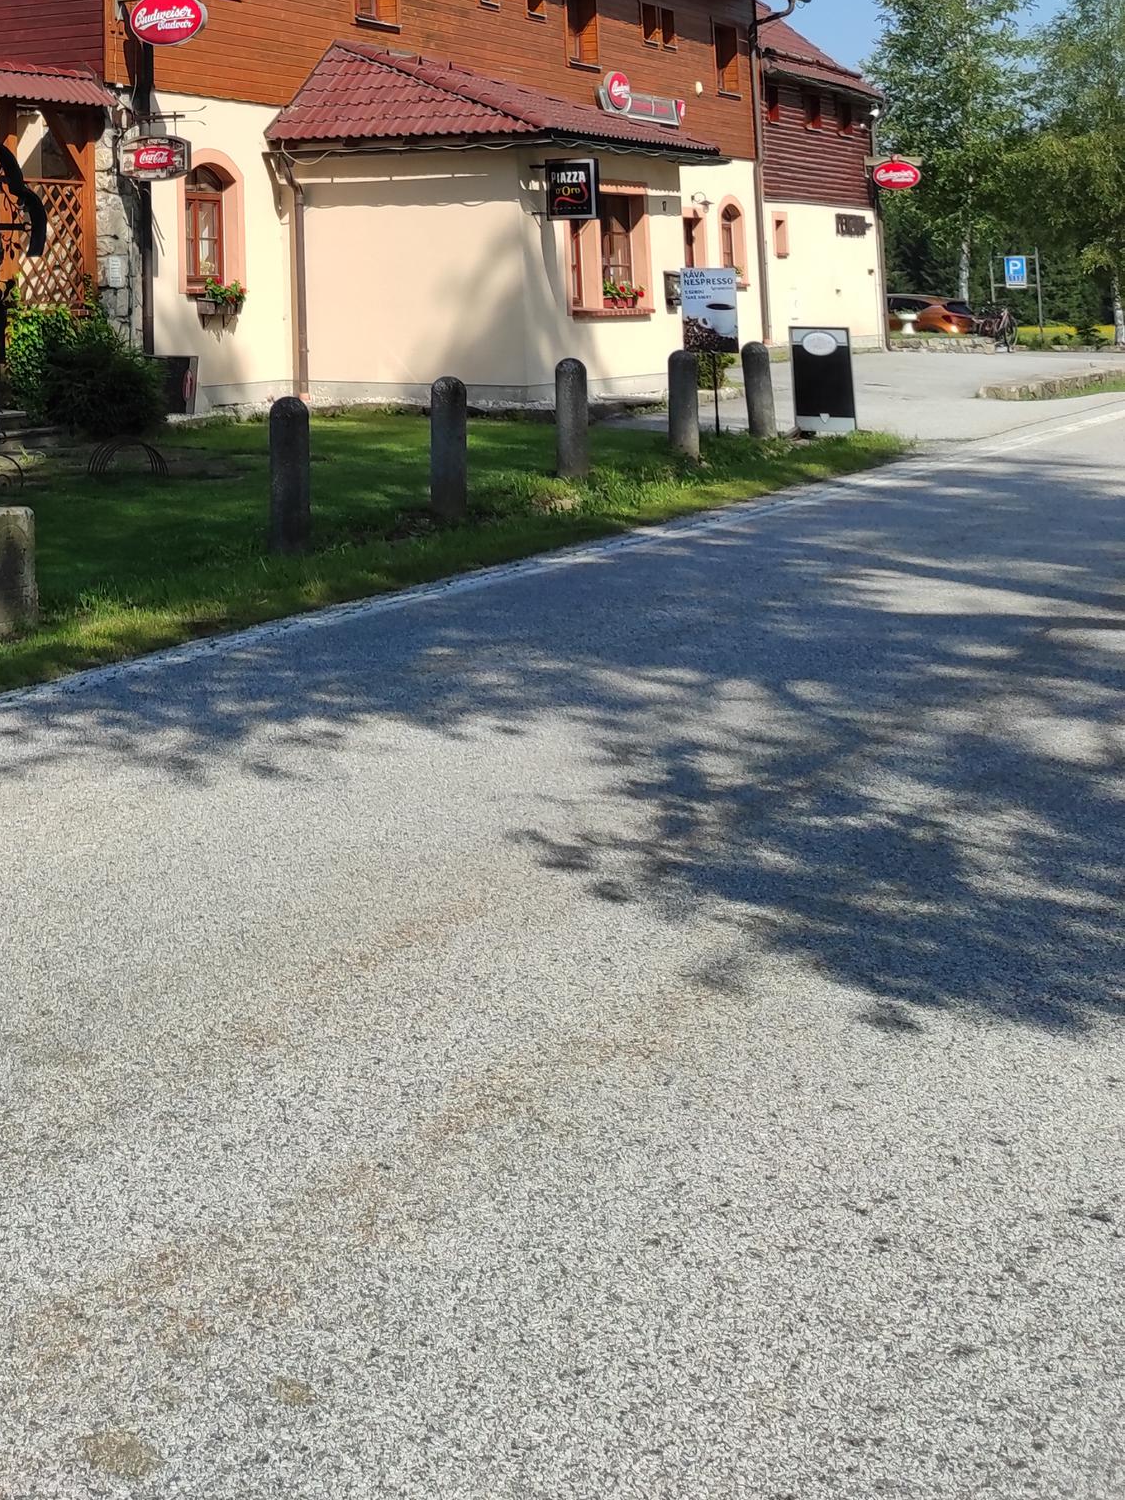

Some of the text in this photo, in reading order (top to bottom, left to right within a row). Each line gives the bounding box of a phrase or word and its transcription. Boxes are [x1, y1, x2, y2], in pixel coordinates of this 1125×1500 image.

[135, 5, 195, 30] Budweiser
[550, 171, 586, 184] PIAZZA
[1009, 260, 1021, 275] P
[683, 270, 706, 279] KÁVA
[683, 278, 733, 286] NESPRESSO
